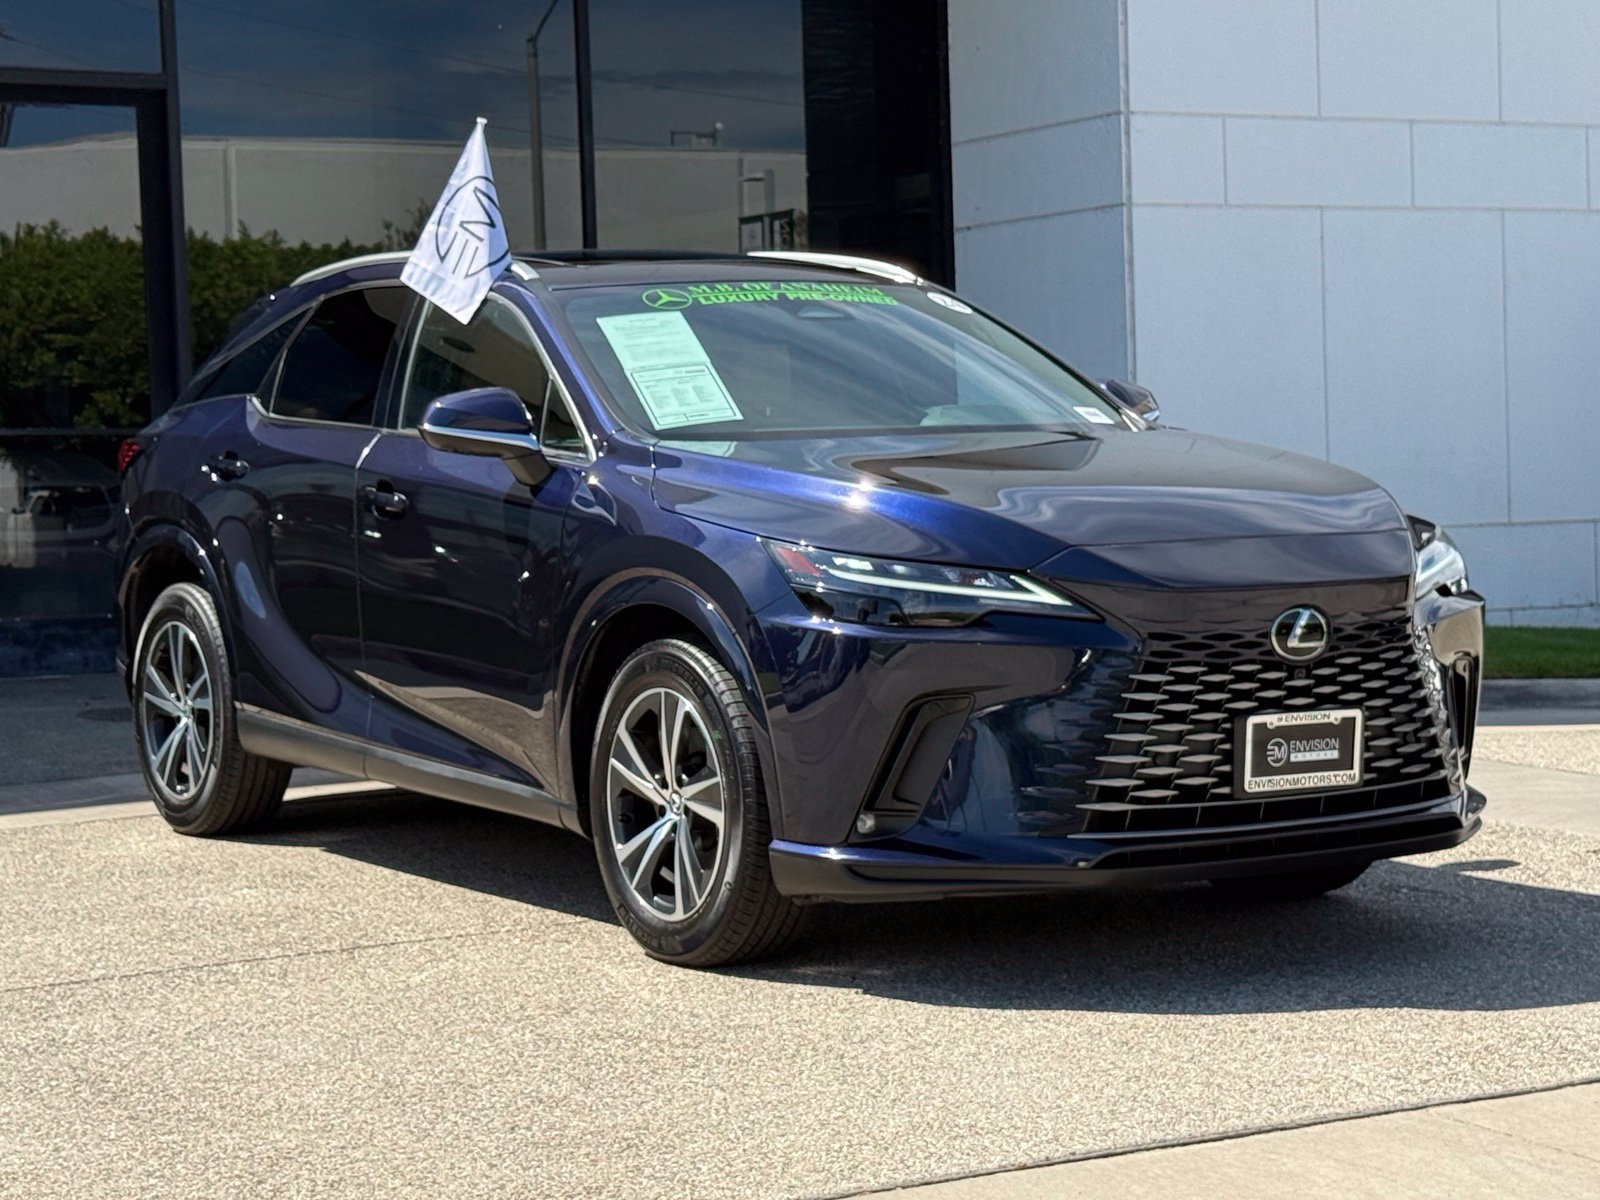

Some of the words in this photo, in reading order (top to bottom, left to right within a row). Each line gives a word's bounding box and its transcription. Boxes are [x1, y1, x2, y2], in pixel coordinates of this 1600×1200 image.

[699, 292, 779, 305] LUXURY
[785, 291, 898, 306] PRE-OWNED
[1284, 712, 1331, 723] ENVISION
[1289, 737, 1340, 752] ENVISION
[1247, 772, 1357, 791] ENVISIONMOTORS.COM
